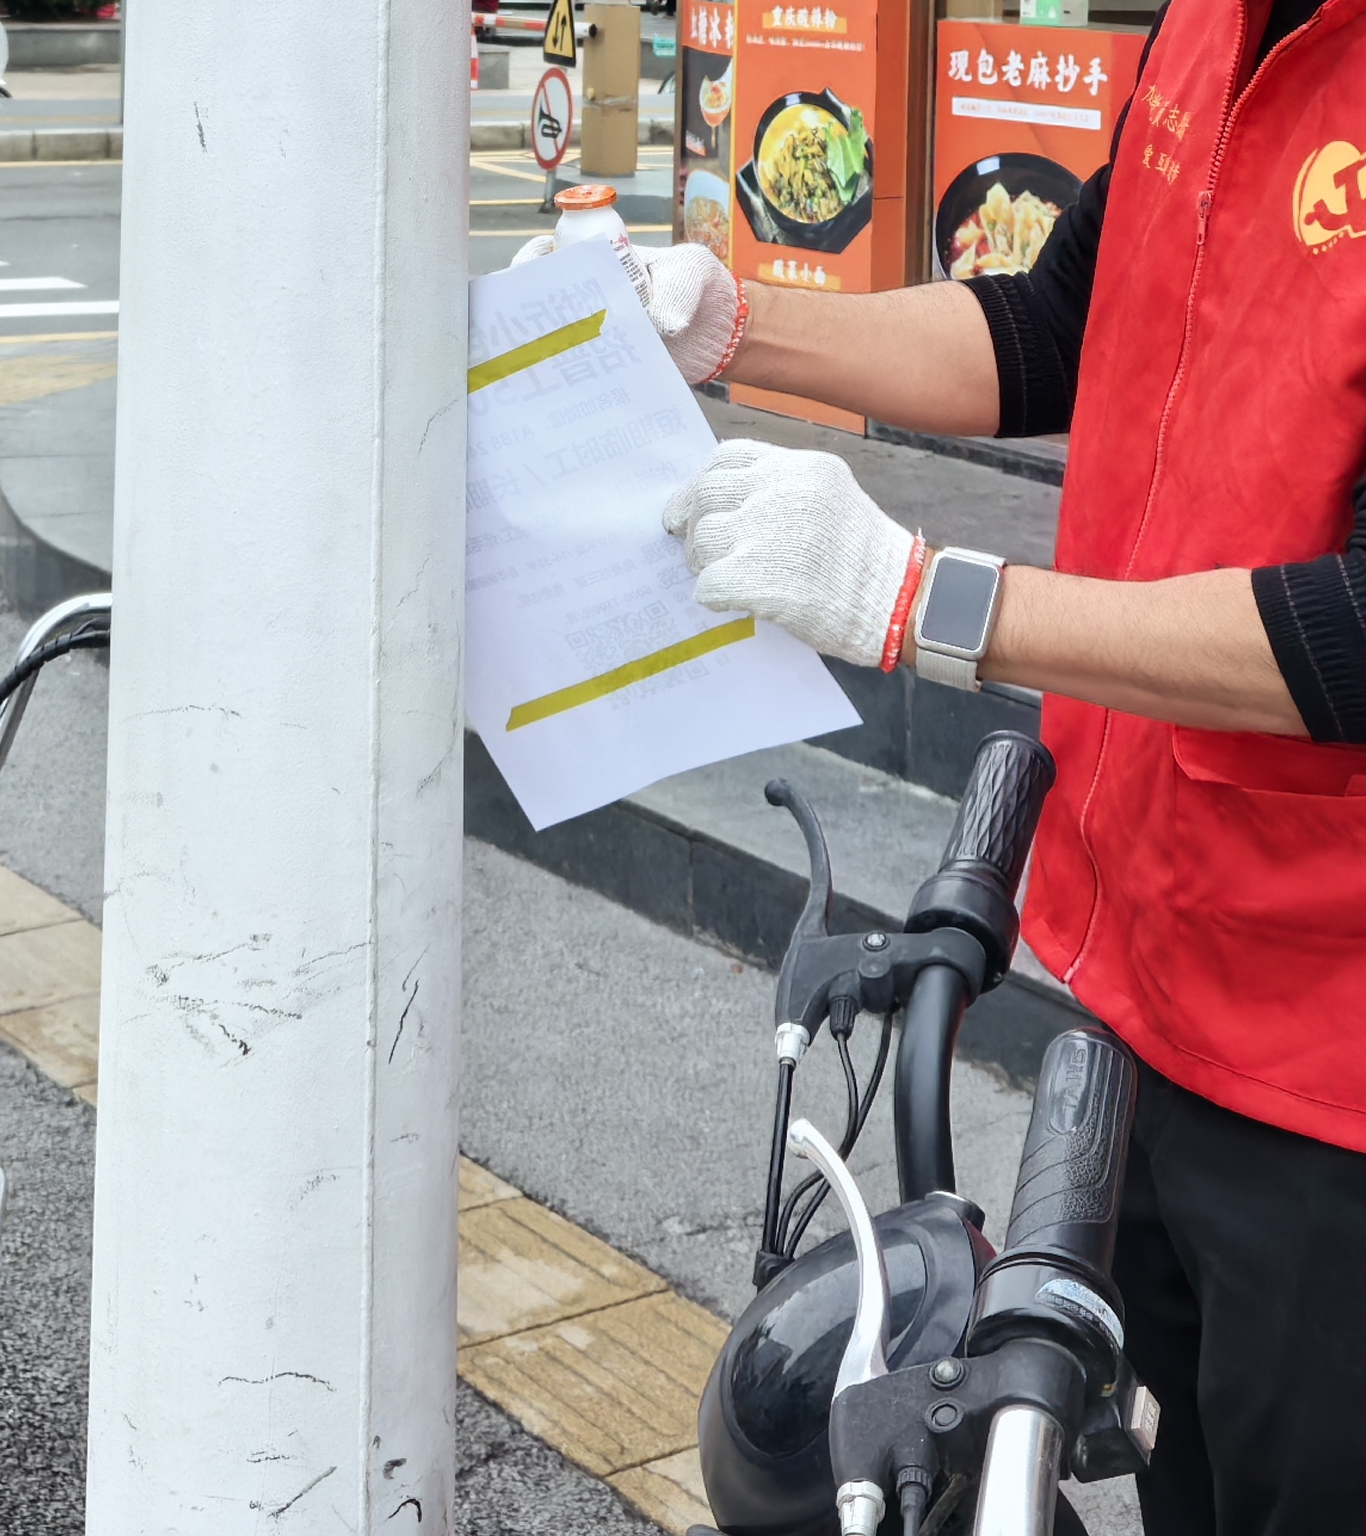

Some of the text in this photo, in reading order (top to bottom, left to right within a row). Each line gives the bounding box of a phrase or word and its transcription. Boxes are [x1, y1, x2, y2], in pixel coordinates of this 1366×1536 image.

[947, 47, 1109, 96] 现包老麻抄手
